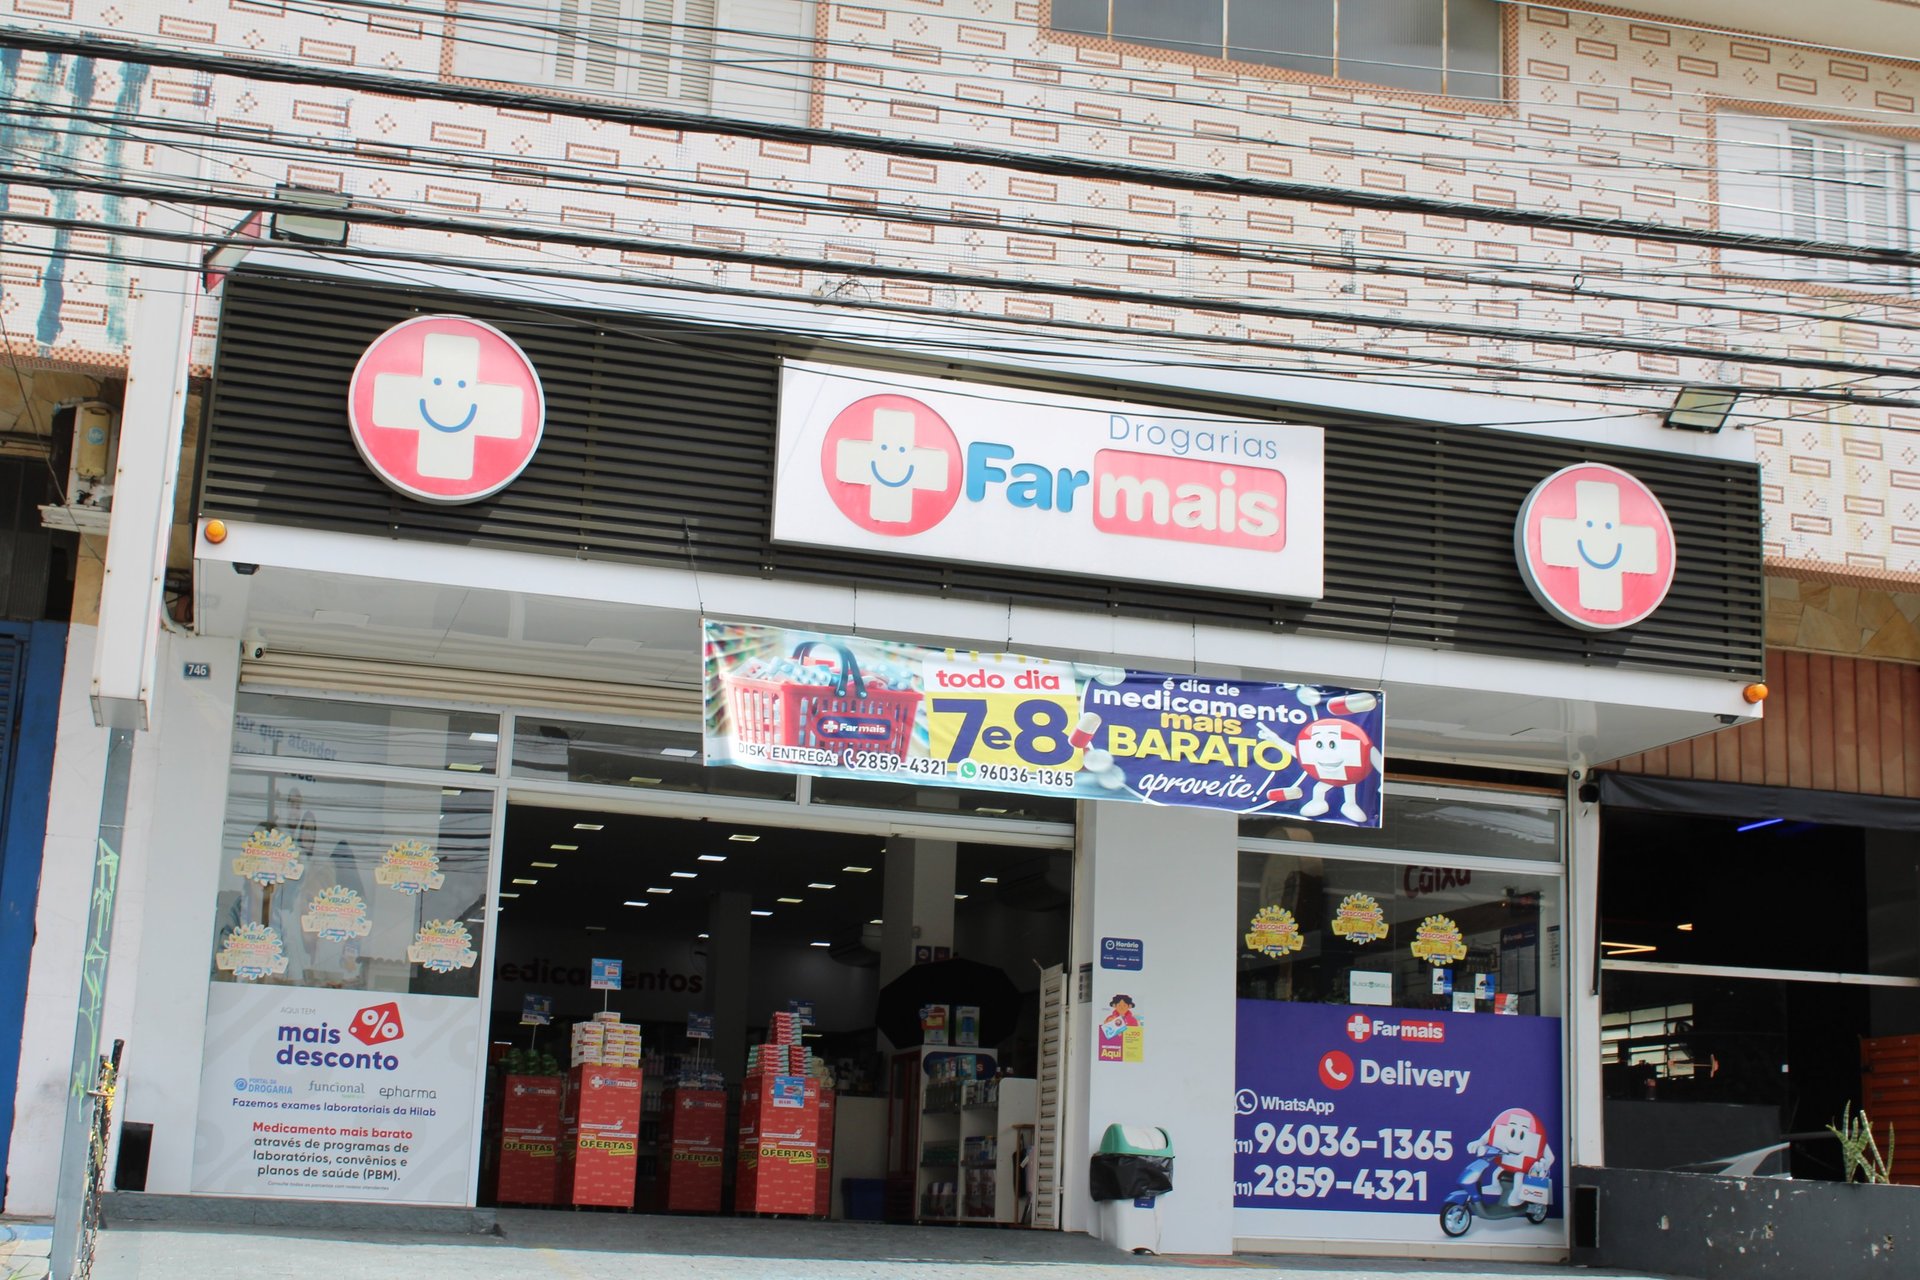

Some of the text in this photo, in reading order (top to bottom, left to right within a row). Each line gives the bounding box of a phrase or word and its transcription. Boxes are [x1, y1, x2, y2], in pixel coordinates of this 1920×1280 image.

[1108, 414, 1278, 461] Drogarias
[188, 664, 207, 676] 746
[935, 668, 1061, 691] todo dia
[1162, 677, 1240, 696] é dia de
[1093, 688, 1307, 724] medicamento
[1160, 710, 1242, 735] mais
[1108, 724, 1292, 771] BARATO
[738, 742, 1074, 787] DISK ENTREGA: 2859-4321 96036-1365
[1138, 771, 1275, 803] aproveite!
[278, 1022, 341, 1044] mais
[276, 1044, 399, 1071] desconto
[1360, 1059, 1471, 1094] Delivery
[248, 1080, 437, 1099] DROGARIA funcional epharma
[232, 1098, 436, 1117] Fazemos exames laboratoriais da Hilab
[1261, 1095, 1335, 1116] WhatsApp
[253, 1121, 413, 1139] Medicamento mais barato
[254, 1136, 409, 1153] através de programas de
[580, 1140, 633, 1150] OFERTAS
[761, 1148, 812, 1158] OFERTAS
[252, 1150, 408, 1167] laboratórios, convênios e
[257, 1165, 401, 1181] planos de saúde (PBM).
